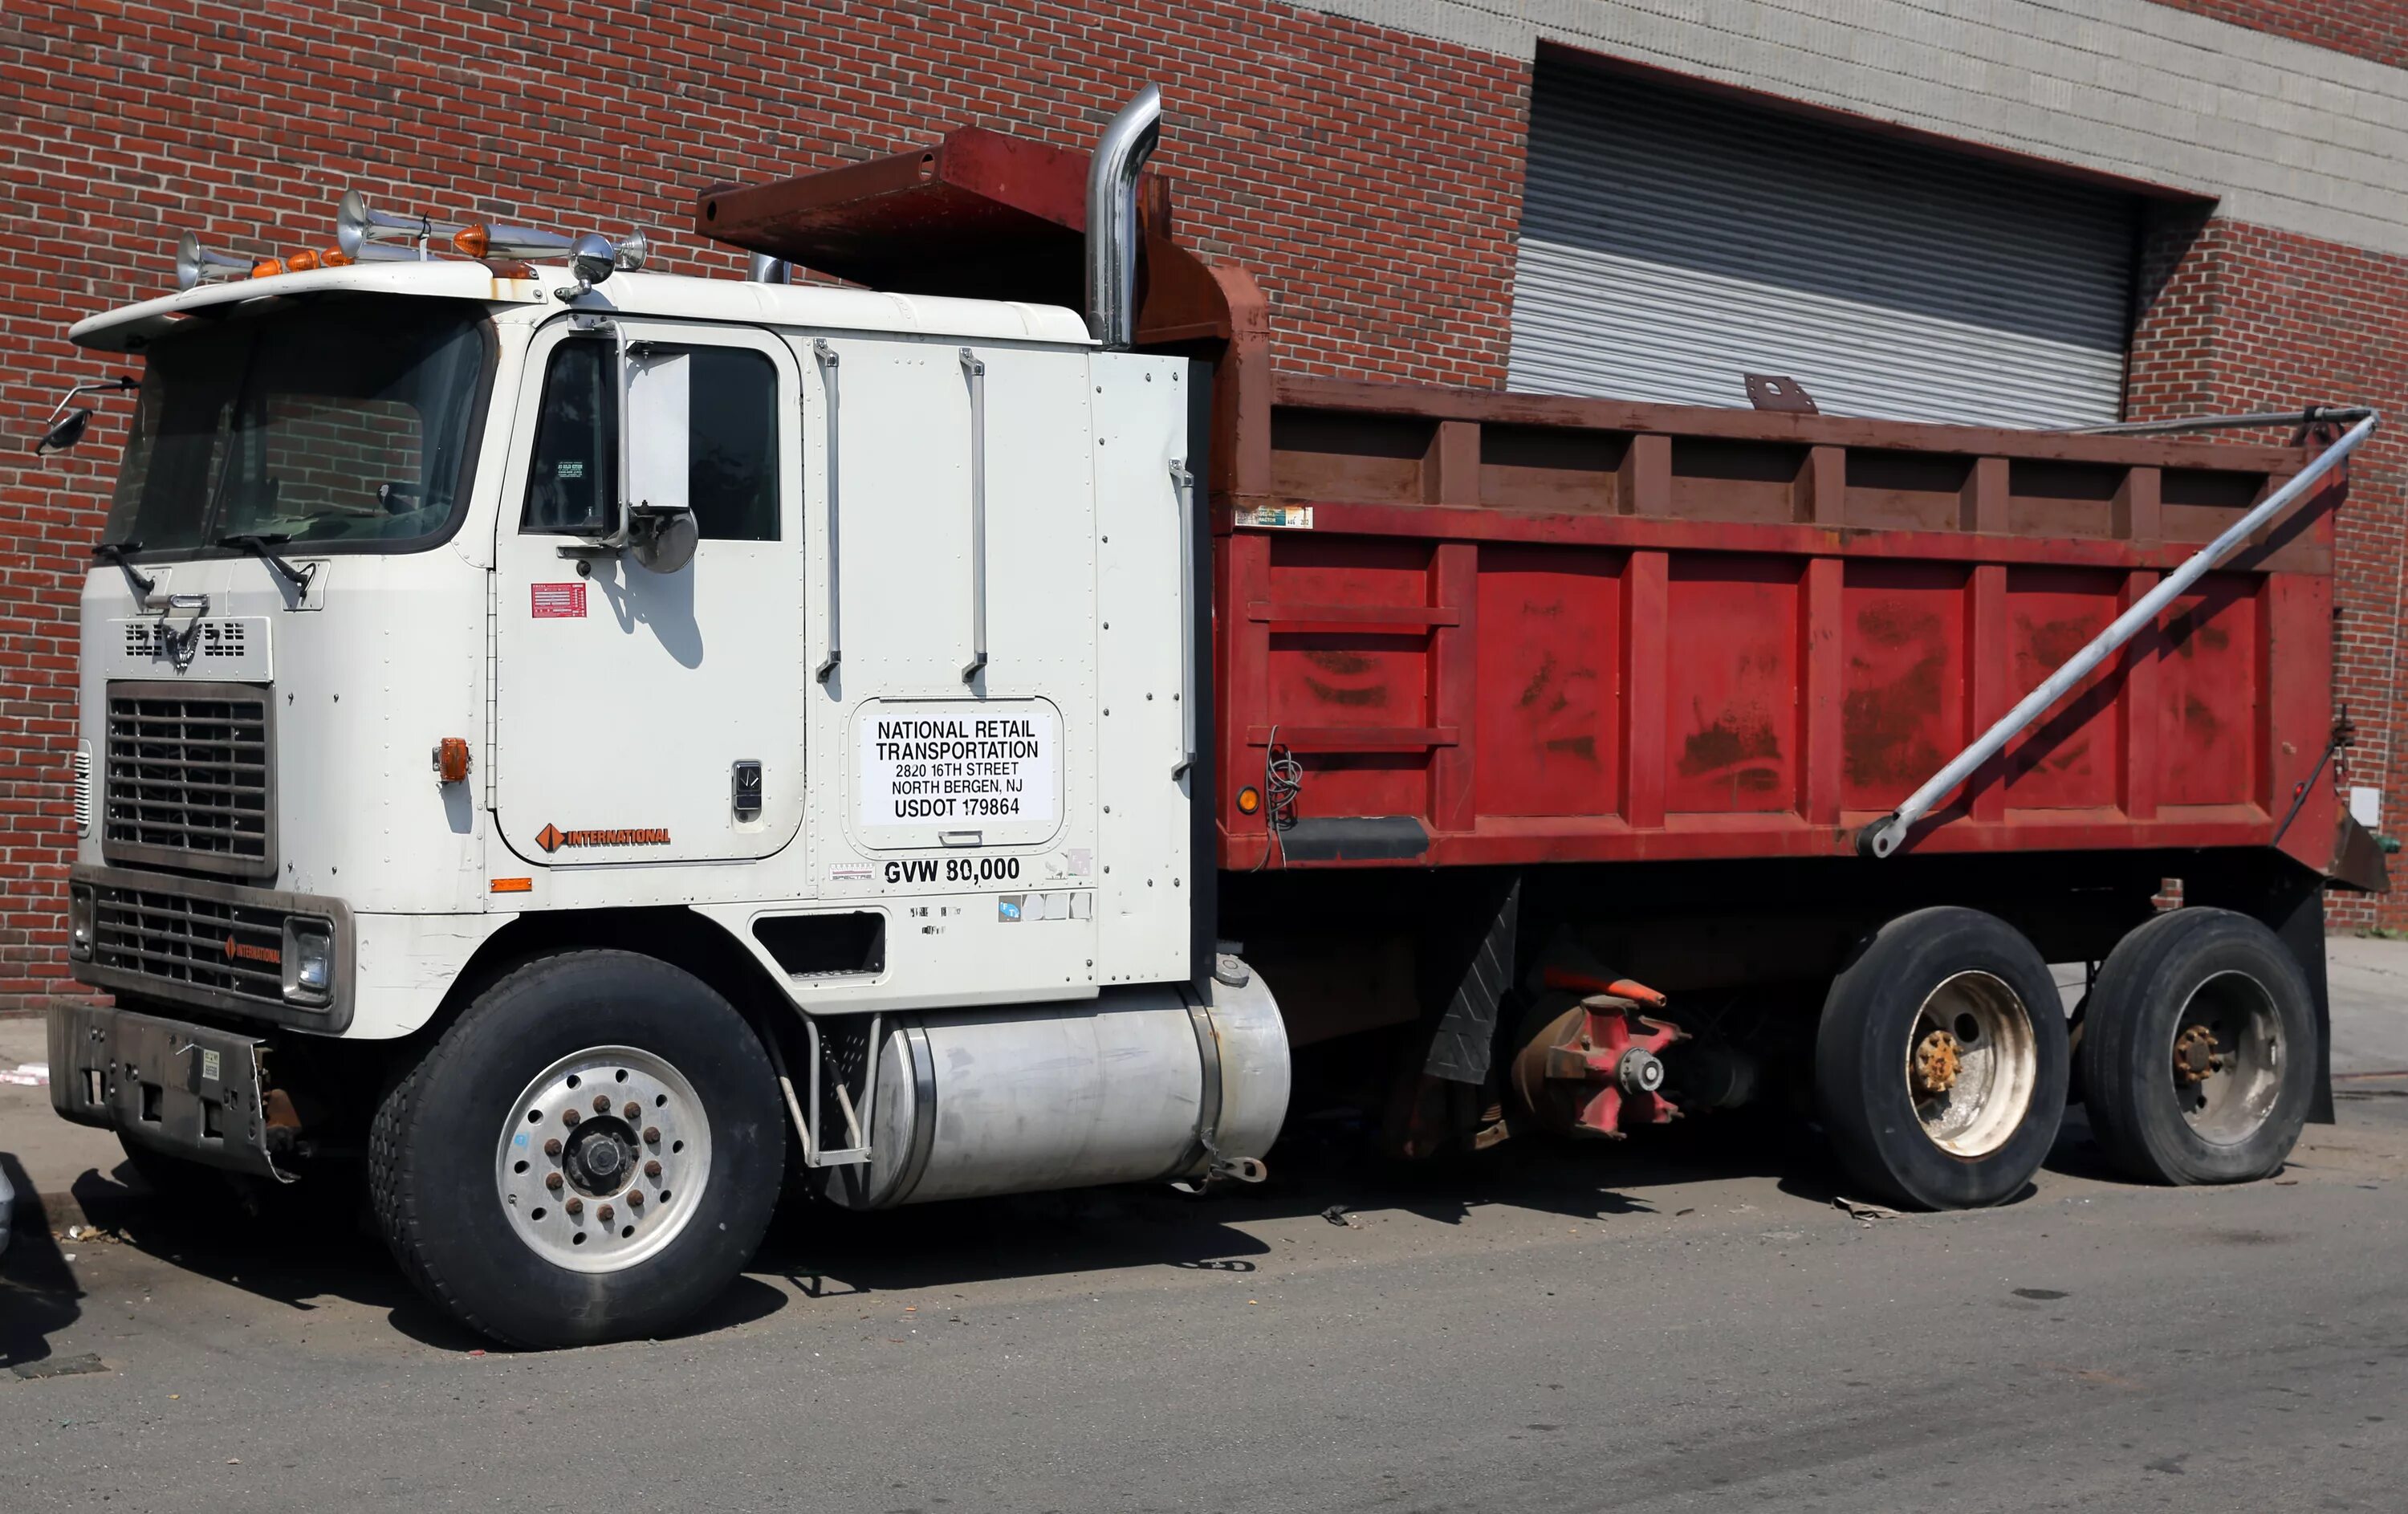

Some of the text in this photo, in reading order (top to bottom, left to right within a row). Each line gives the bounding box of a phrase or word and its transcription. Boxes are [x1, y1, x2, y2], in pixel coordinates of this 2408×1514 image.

[878, 720, 1035, 739] NATIONAL RETAIL
[876, 741, 1038, 760] TRANSPORTATION
[896, 762, 1019, 777] 2820 16TH STREET
[892, 779, 1022, 795] NORTH BERGEN, NJ
[895, 798, 1019, 817] USDOT 179864
[567, 828, 671, 847] INTERNATIONAL
[885, 857, 1019, 885] GVW 80,000
[237, 944, 281, 963] INTERNATIONAL
